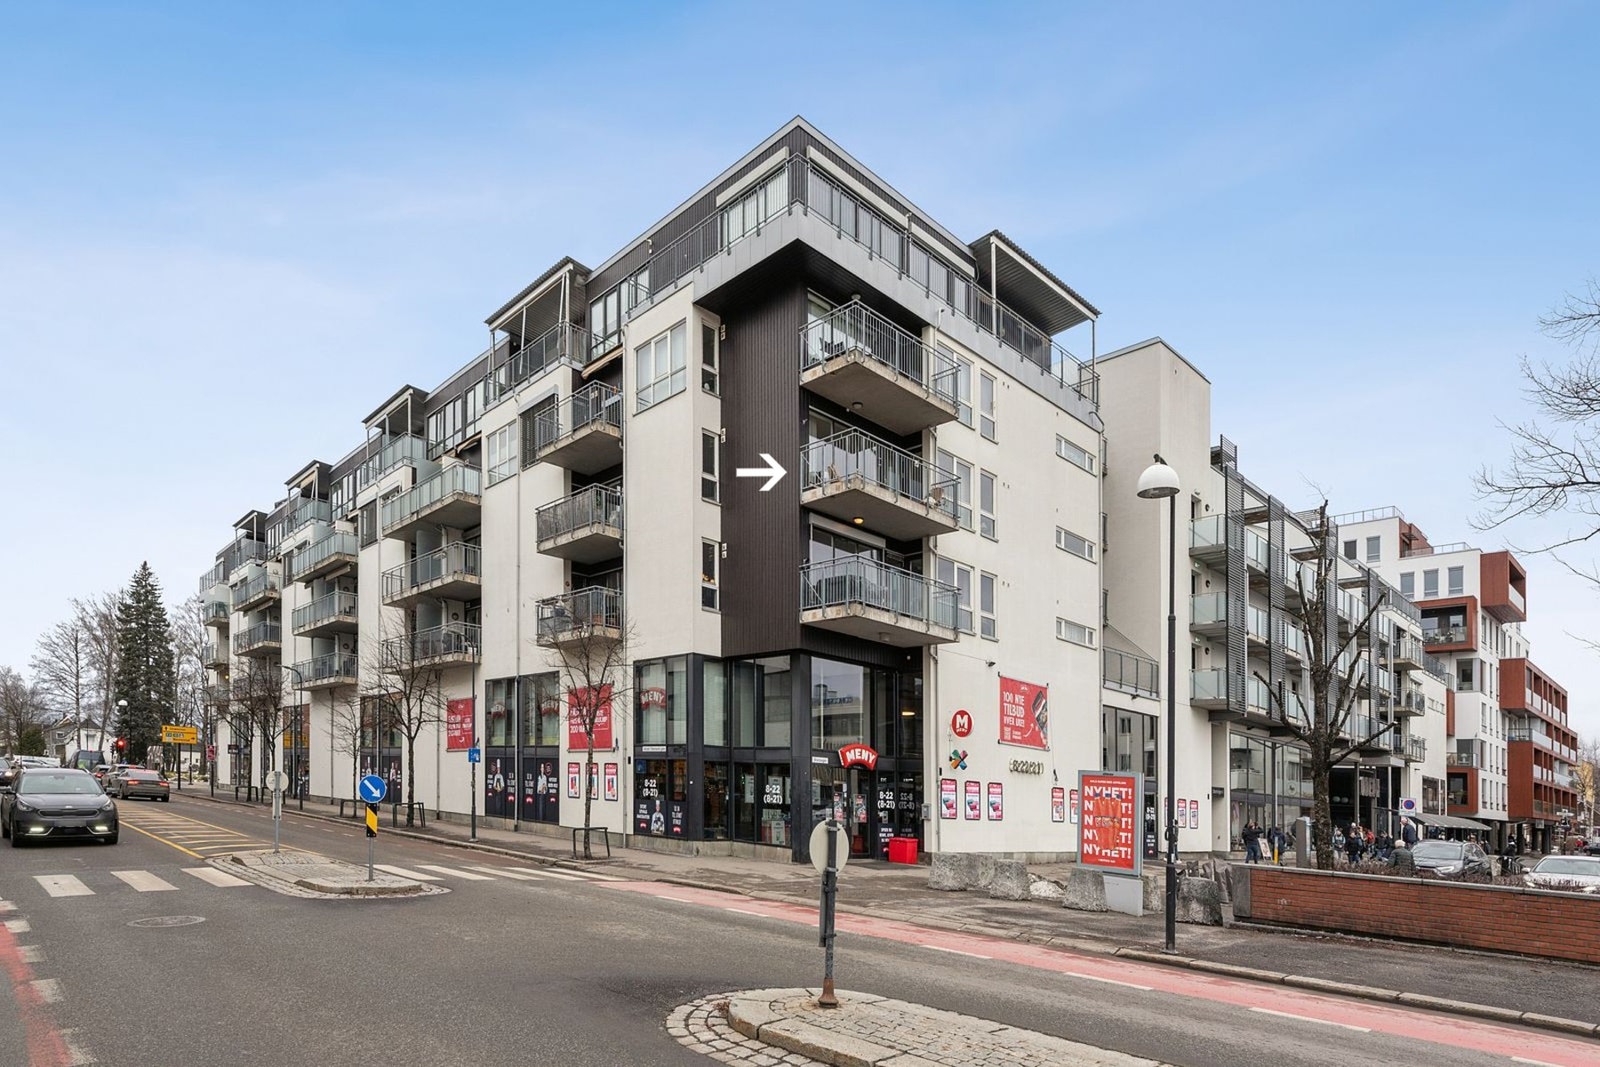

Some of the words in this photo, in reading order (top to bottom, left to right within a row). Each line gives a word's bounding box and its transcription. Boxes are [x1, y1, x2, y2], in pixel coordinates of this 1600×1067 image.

[640, 690, 665, 705] MENY
[1003, 691, 1013, 703] 100
[1003, 703, 1025, 718] TILBUD
[956, 714, 969, 730] M
[845, 748, 876, 764] MENY
[644, 779, 657, 788] 8-22
[765, 784, 781, 794] 8-22
[642, 787, 659, 798] (8-21)
[763, 794, 783, 804] (8-21)
[879, 791, 894, 800] 8-22
[1084, 785, 1132, 800] NYHET!
[877, 800, 896, 809] (8-21)
[1084, 799, 1132, 814] NT!
[1084, 814, 1132, 829] NT!
